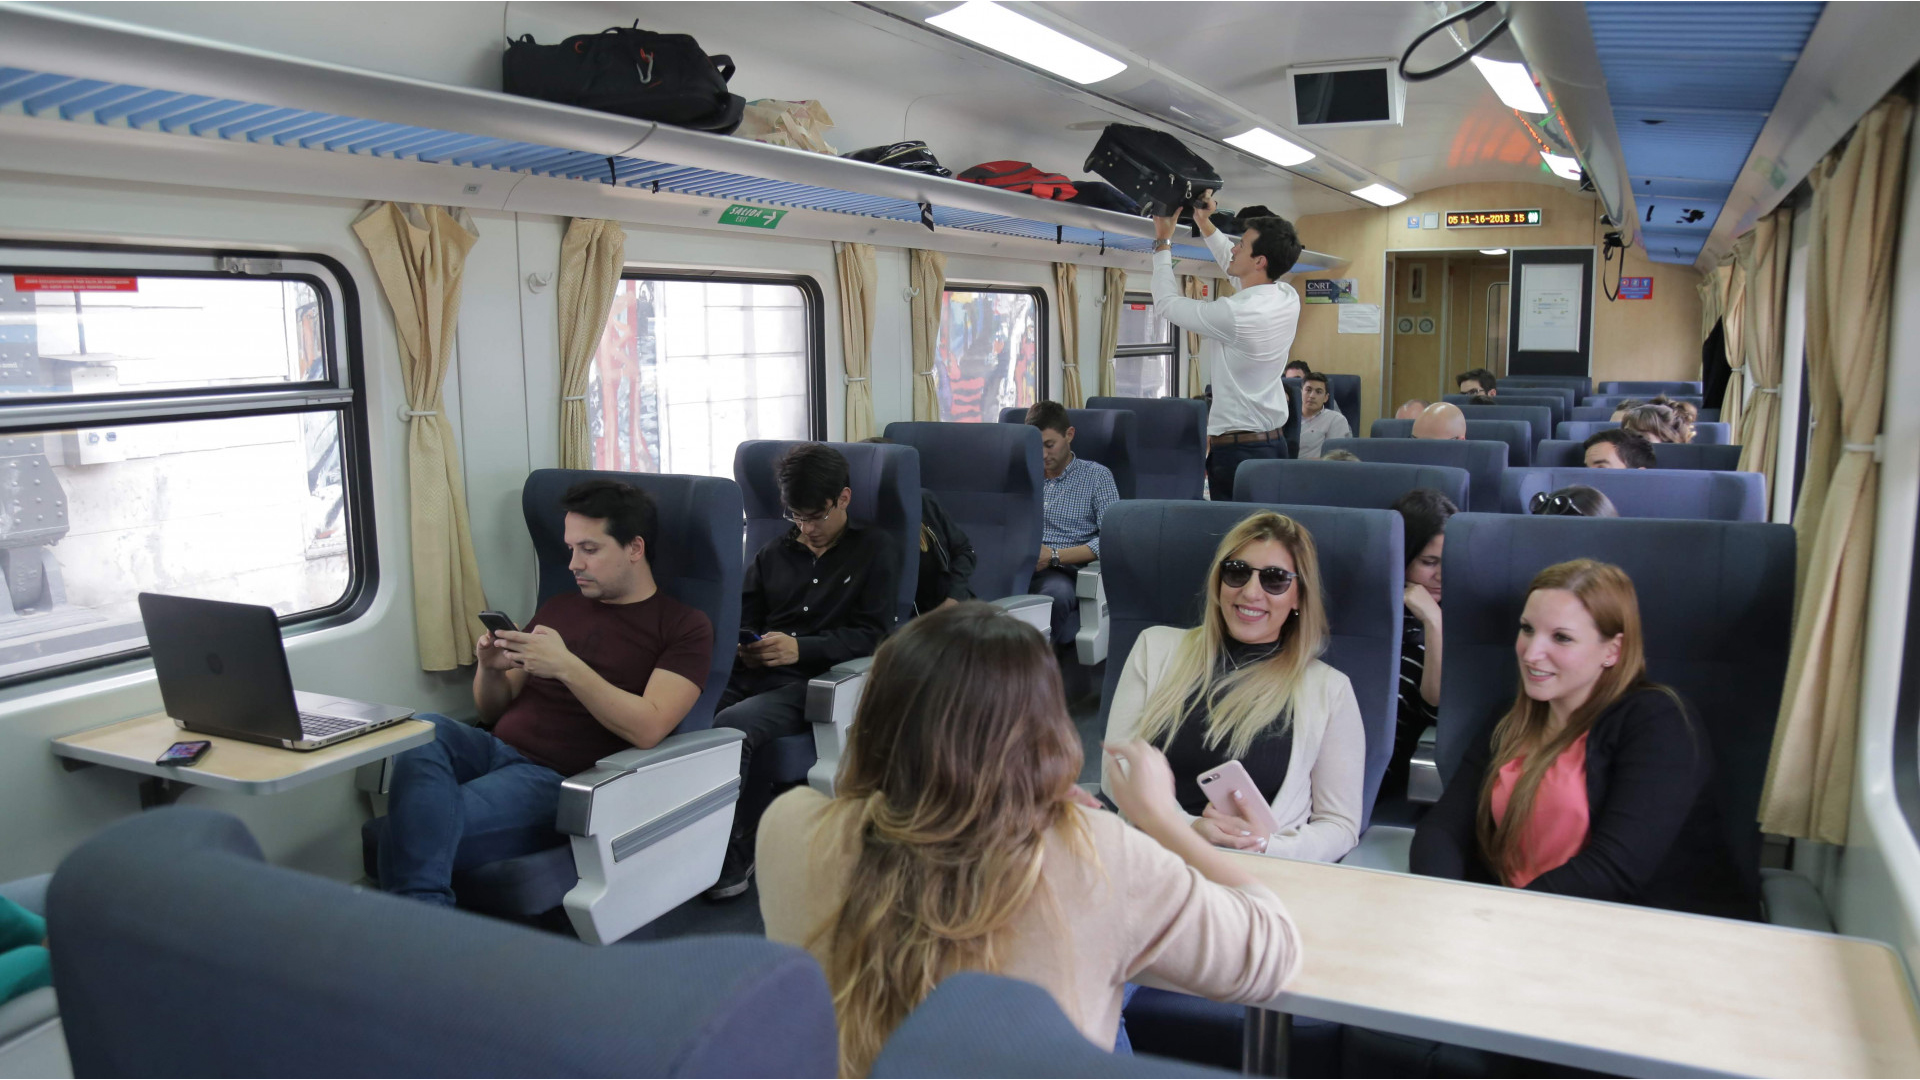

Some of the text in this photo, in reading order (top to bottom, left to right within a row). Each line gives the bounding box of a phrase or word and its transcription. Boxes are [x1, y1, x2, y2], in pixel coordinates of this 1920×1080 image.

[729, 207, 763, 217] SALIDA
[1448, 213, 1525, 224] 05 11-16-2018 15
